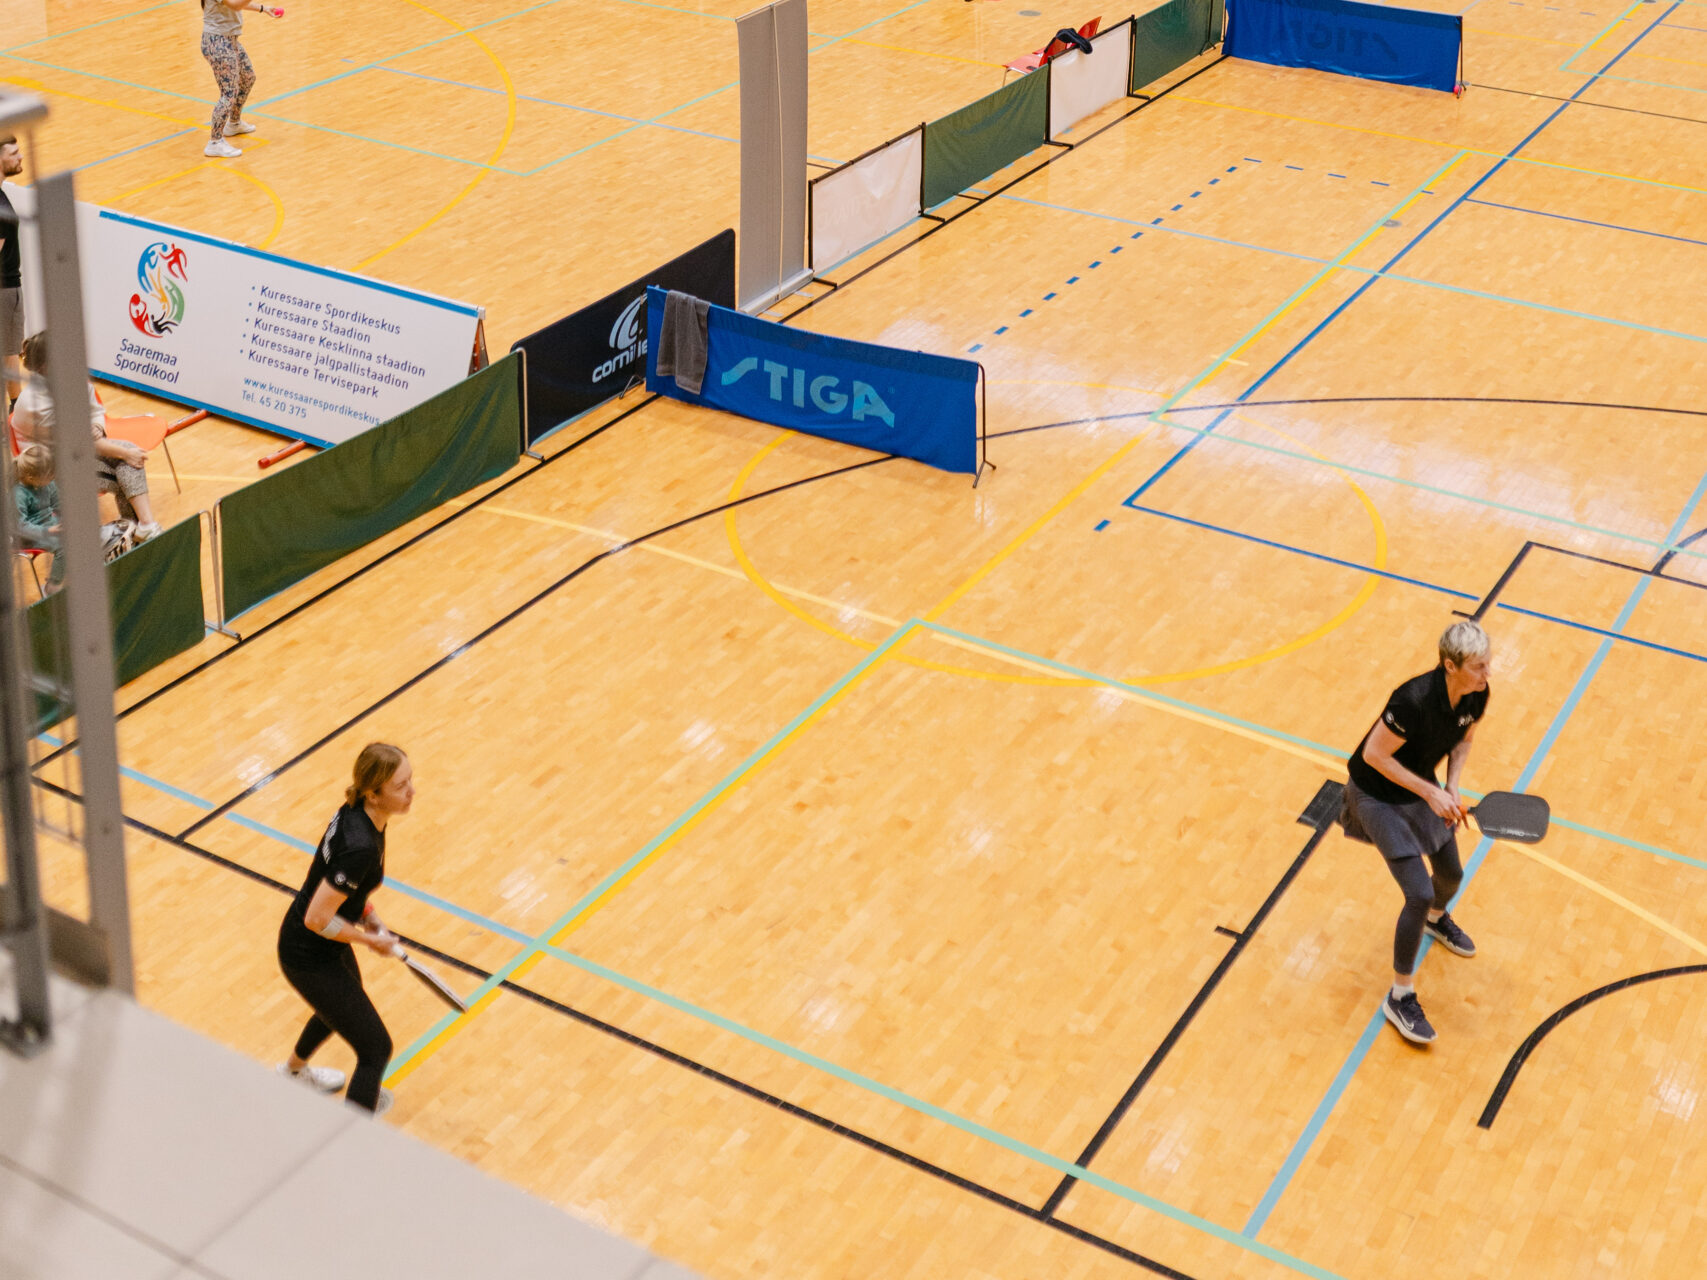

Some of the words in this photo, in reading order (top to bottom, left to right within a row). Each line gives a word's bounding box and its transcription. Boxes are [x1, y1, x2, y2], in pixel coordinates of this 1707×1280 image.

[257, 301, 319, 328] Kuressaare
[322, 320, 371, 344] Staadion
[260, 285, 322, 312] Kuressaare
[325, 303, 401, 335] Spordikeskus
[114, 353, 180, 384] Spordikool
[120, 338, 178, 366] Saaremaa
[251, 333, 312, 360] Kuressaare
[314, 351, 409, 390] jalgpallistaadion
[254, 317, 315, 344] Kuressaare
[318, 336, 372, 362] Kesklinna
[376, 354, 426, 378] staadion
[248, 349, 309, 376] Kuressaare
[313, 368, 379, 398] Tervisepark
[721, 357, 895, 428] STIGA
[242, 390, 257, 404] Tel.
[259, 395, 271, 408] 45
[274, 400, 286, 412] 20
[288, 405, 308, 419] 375
